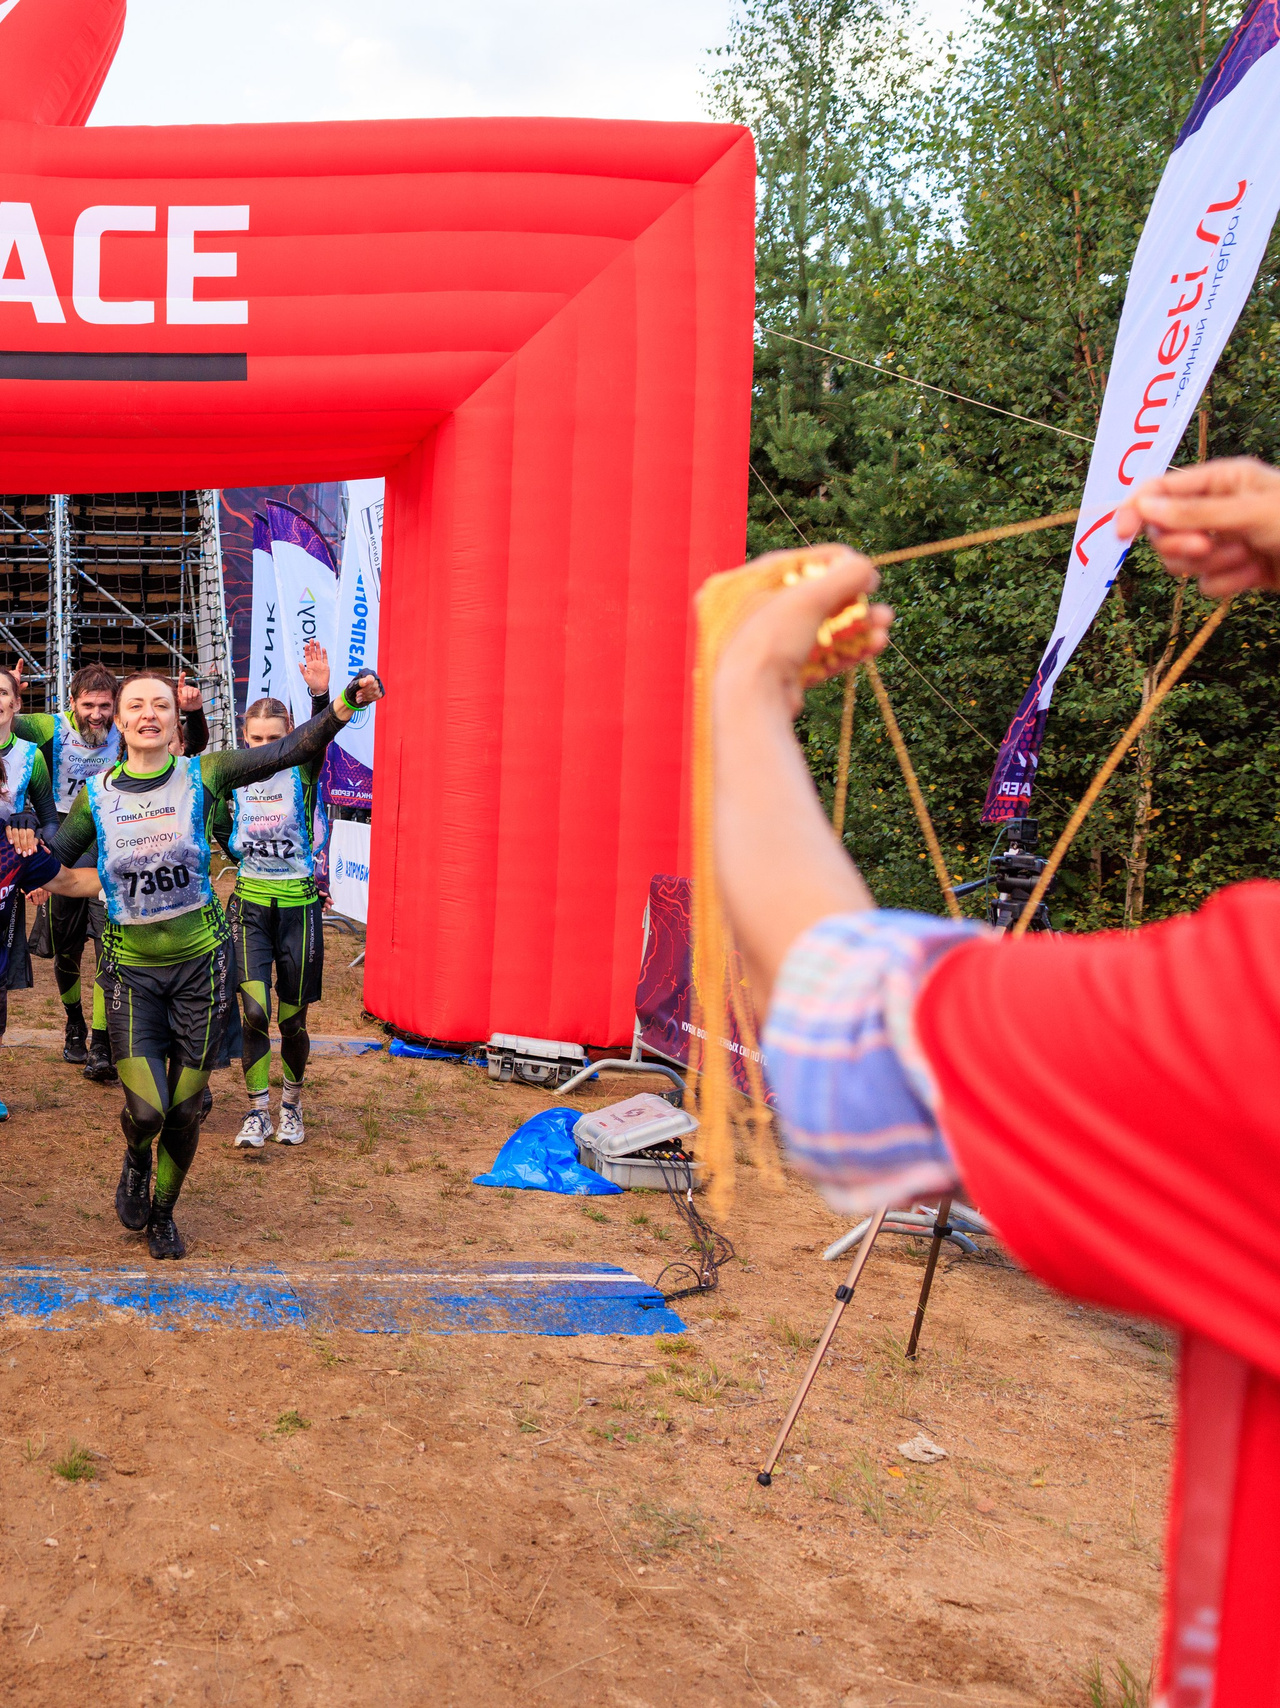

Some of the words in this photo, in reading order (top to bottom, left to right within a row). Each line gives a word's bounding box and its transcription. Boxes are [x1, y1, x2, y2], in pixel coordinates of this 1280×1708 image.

[116, 812, 143, 823] ГОНКА
[145, 806, 176, 819] ГЕРОЕВ
[241, 813, 281, 823] Greenway
[116, 832, 174, 849] Greenway
[242, 839, 295, 859] 7312
[122, 864, 190, 898] 7360
